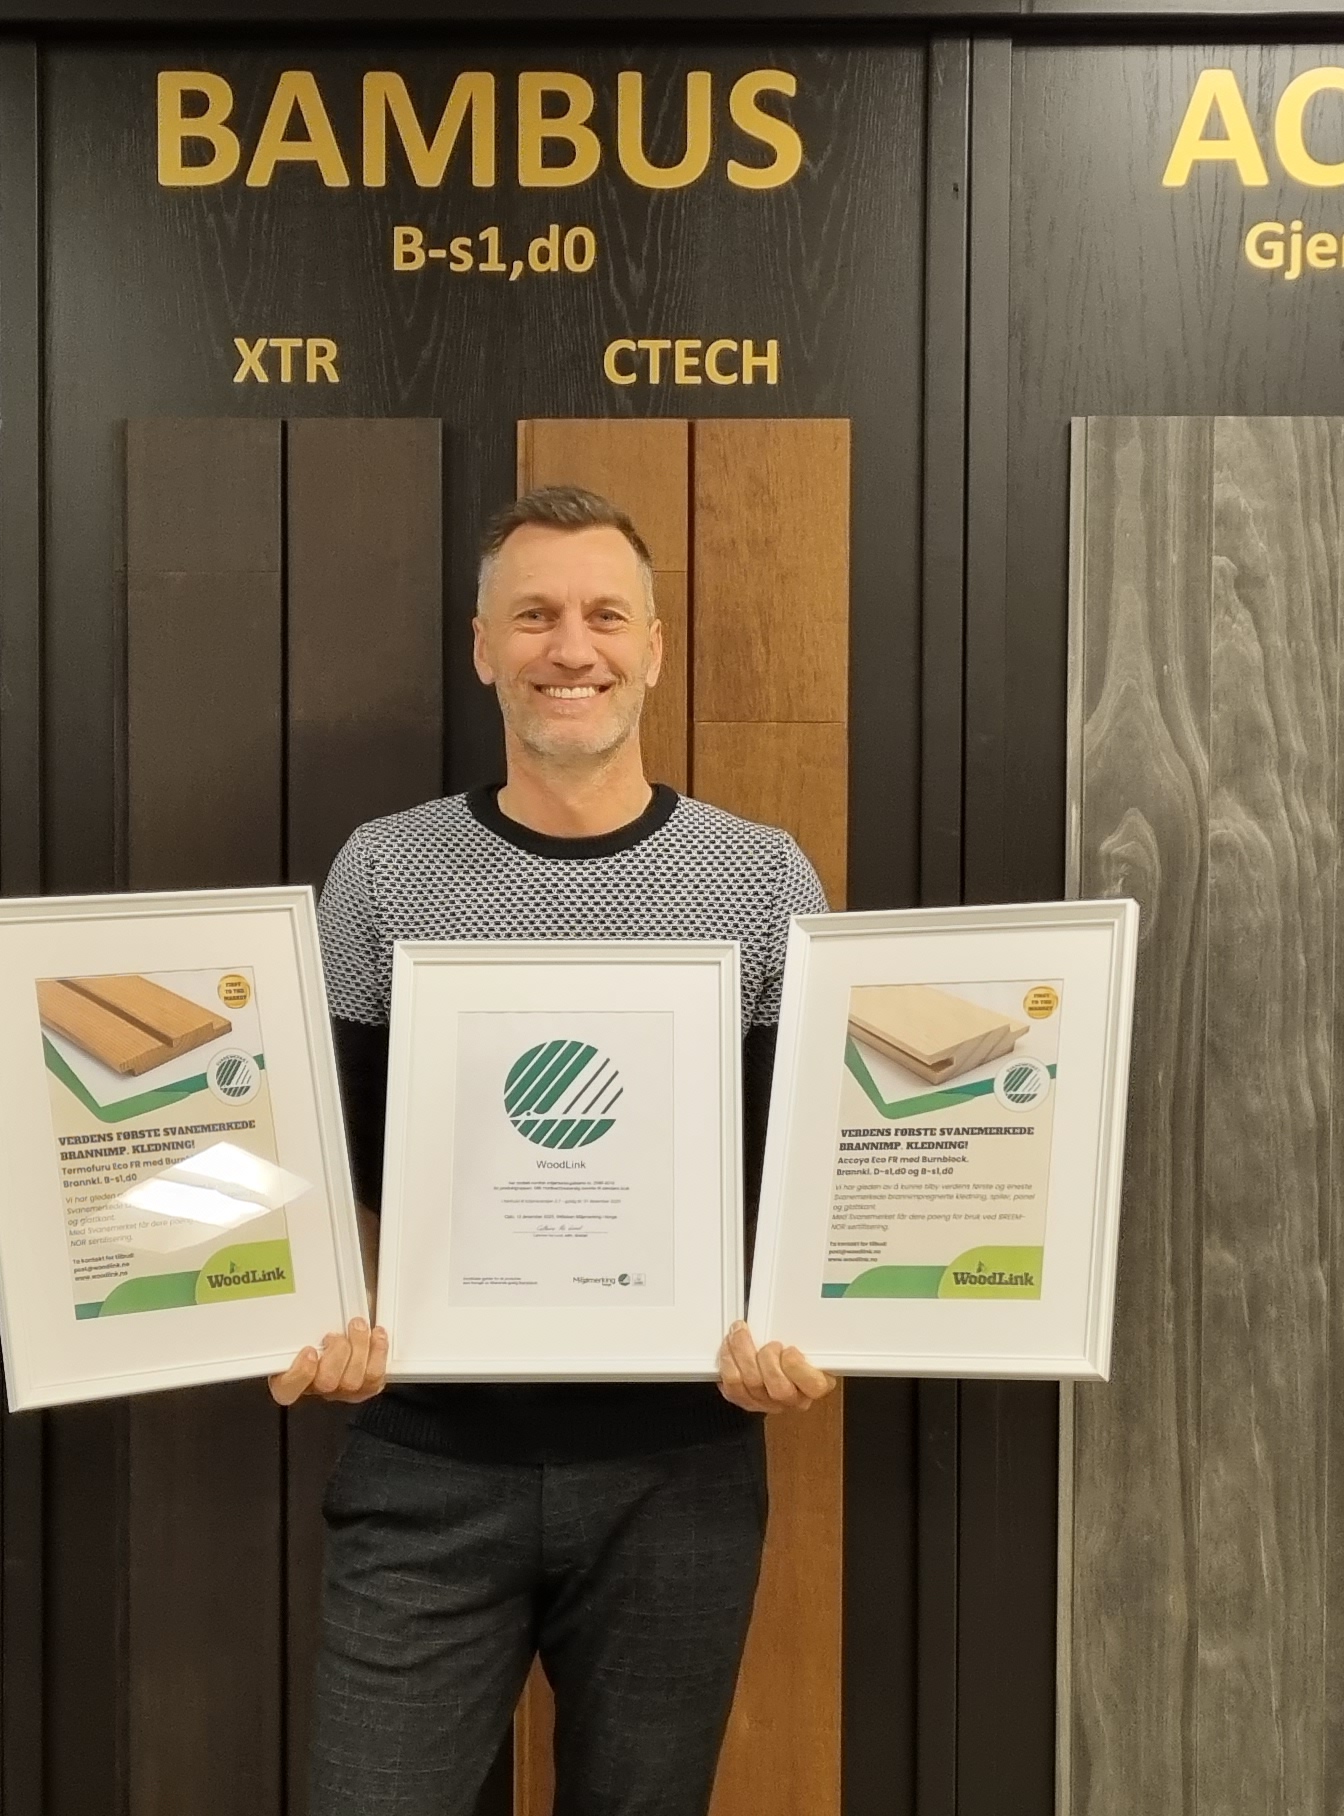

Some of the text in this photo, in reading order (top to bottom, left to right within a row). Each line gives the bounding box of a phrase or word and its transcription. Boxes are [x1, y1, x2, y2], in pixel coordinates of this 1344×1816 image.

[157, 69, 803, 190] BAMBUS
[394, 225, 596, 280] B-s1,d0
[236, 338, 339, 382] XTR
[604, 338, 778, 385] CTECH
[58, 1120, 256, 1146] VERDENS FØRSTE SVANEMERKEDE
[841, 1127, 1035, 1137] VERDENS FØRSTE SVANEMERKEDE
[60, 1140, 195, 1161] BRANNIMP. KLEDNING!
[906, 1141, 969, 1150] KLEDNING!
[61, 1162, 111, 1176] Termofuru
[113, 1161, 128, 1170] Eco
[130, 1160, 141, 1169] FR
[143, 1157, 163, 1167] med
[536, 1160, 586, 1169] WoodLink
[838, 1157, 870, 1166] Accoya
[871, 1156, 887, 1164] Eco
[908, 1168, 919, 1178] og
[63, 1177, 103, 1188] Brannkl.
[68, 1219, 78, 1227] og
[70, 1239, 87, 1247] NOR
[207, 1267, 286, 1289] WoodLink
[952, 1271, 1034, 1286] WoodLink
